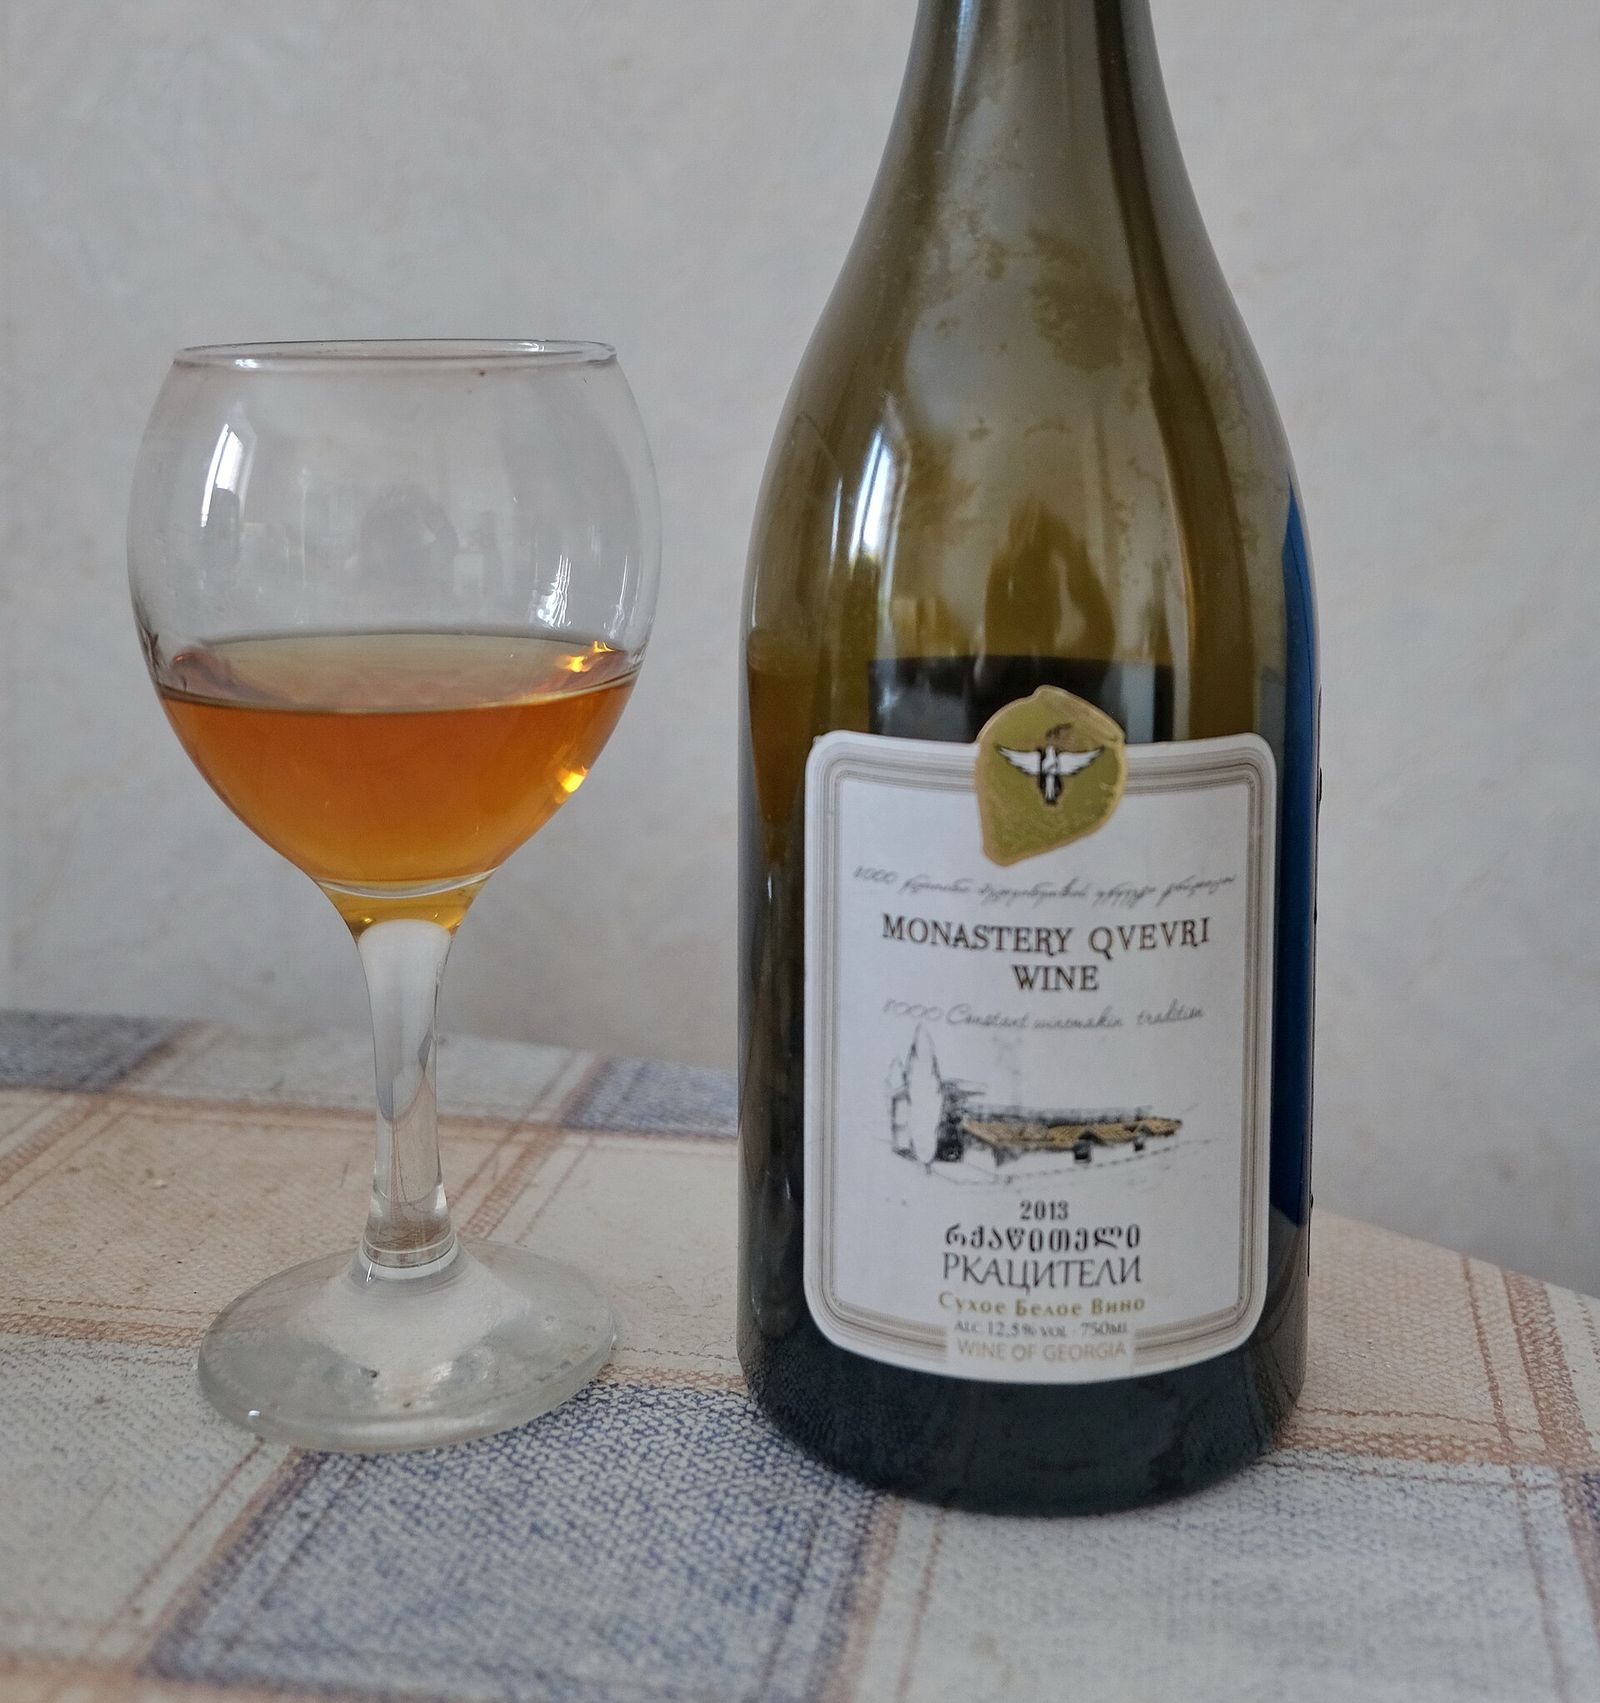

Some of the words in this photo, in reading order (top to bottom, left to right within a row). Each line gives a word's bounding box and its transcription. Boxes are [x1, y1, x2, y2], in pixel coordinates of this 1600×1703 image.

[881, 912, 1073, 957] MONASTERY
[1088, 916, 1211, 961] QVEVRI
[1012, 964, 1100, 992] WINE
[1019, 1199, 1069, 1221] 2013
[945, 1223, 1141, 1252] რქაწითელი
[942, 1252, 1142, 1296] РКАЦИТЕЛИ
[938, 1290, 1008, 1317] Сухое
[1014, 1297, 1083, 1318] Белое
[1090, 1296, 1146, 1317] Вино
[956, 1336, 1003, 1362] WINE
[1011, 1341, 1038, 1362] OF
[1042, 1339, 1129, 1363] GEORGIA
